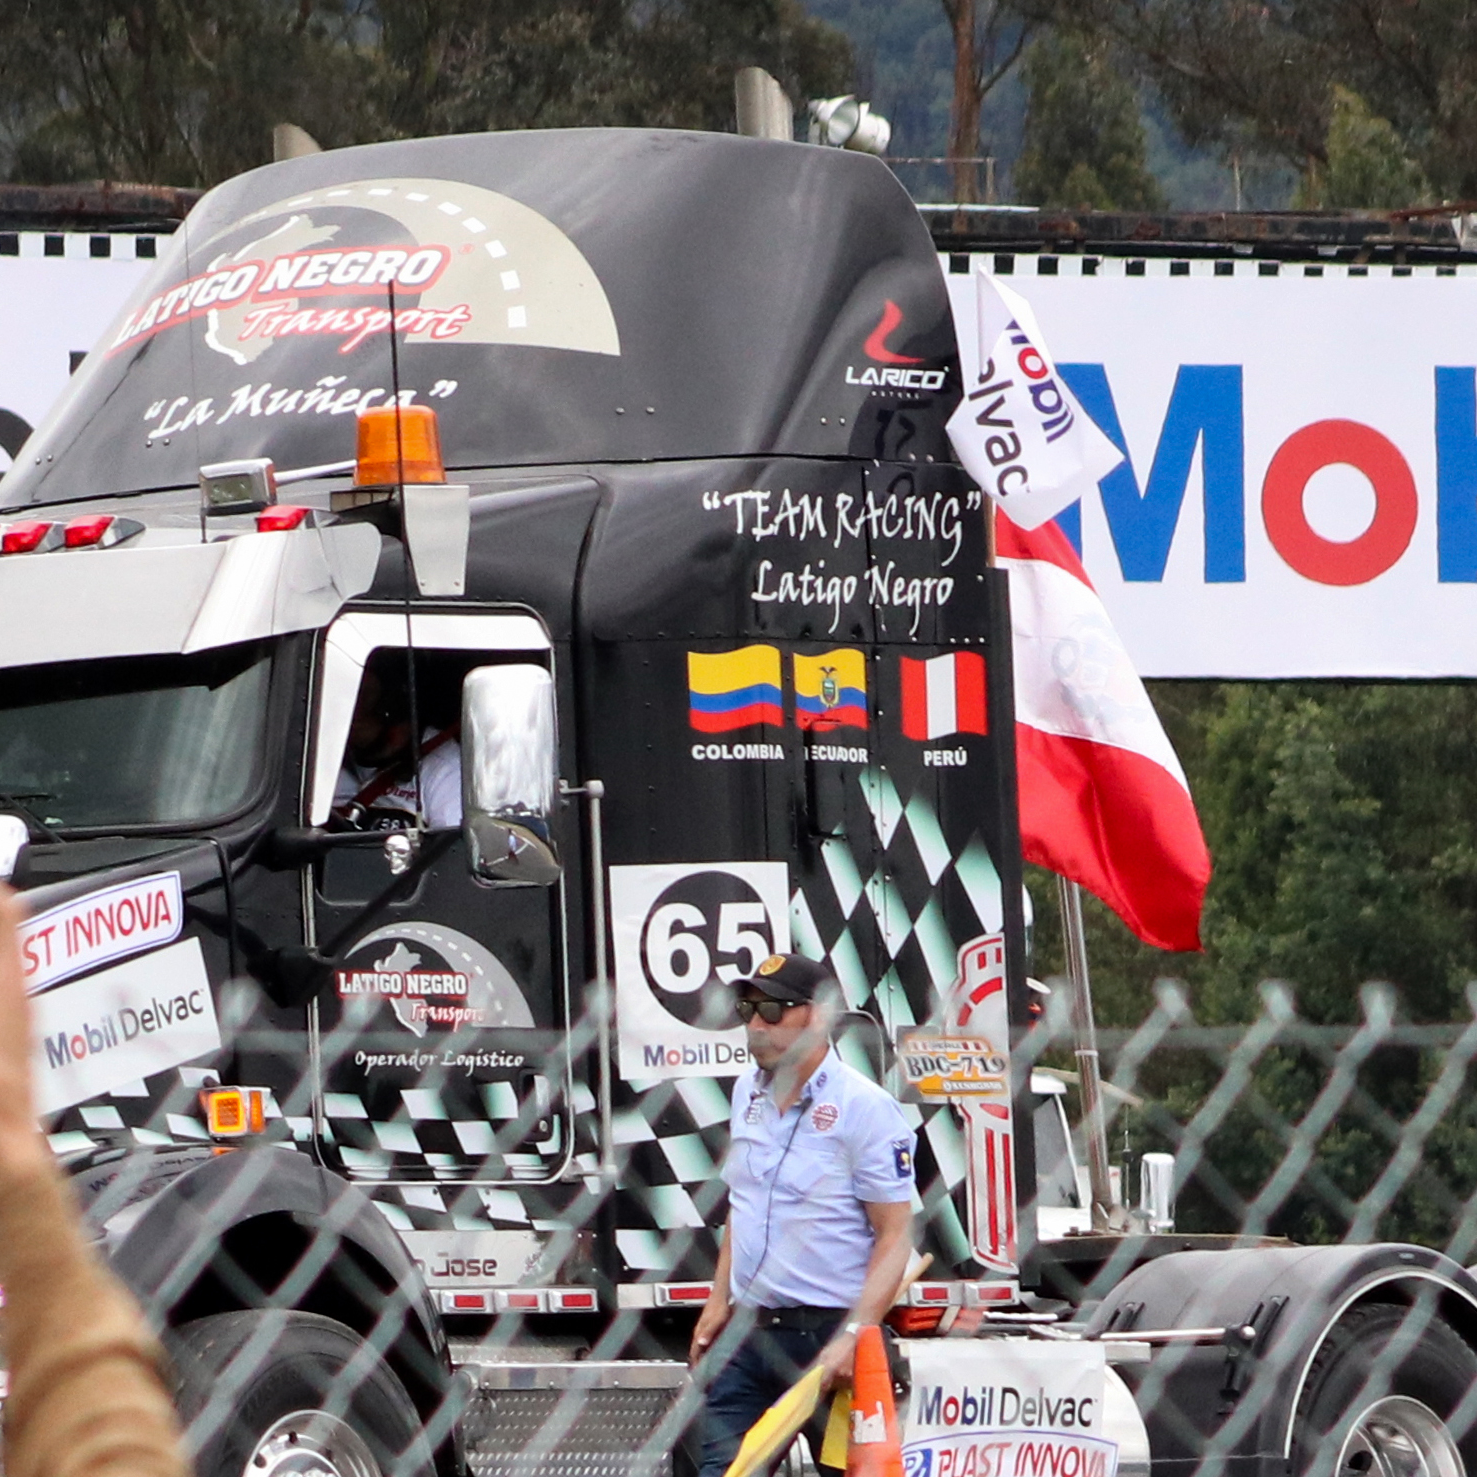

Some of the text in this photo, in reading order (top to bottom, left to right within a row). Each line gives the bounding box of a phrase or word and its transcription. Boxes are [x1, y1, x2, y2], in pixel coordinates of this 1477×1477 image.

[113, 249, 439, 350] LATIGO NEGRO
[241, 305, 467, 353] Transport
[845, 366, 945, 389] LARICO
[751, 563, 954, 635] Latigo Negro
[691, 744, 785, 760] COLOMBIA
[923, 747, 968, 766] PERÚ
[66, 889, 172, 958] INNOVA
[645, 902, 770, 993] 65
[338, 972, 467, 995] LATIGO NEGRO
[44, 987, 205, 1070] Mobil Delvac
[354, 1049, 437, 1076] Operador
[644, 1042, 710, 1067] Mobil
[918, 1386, 1092, 1427] Mobil Delvac
